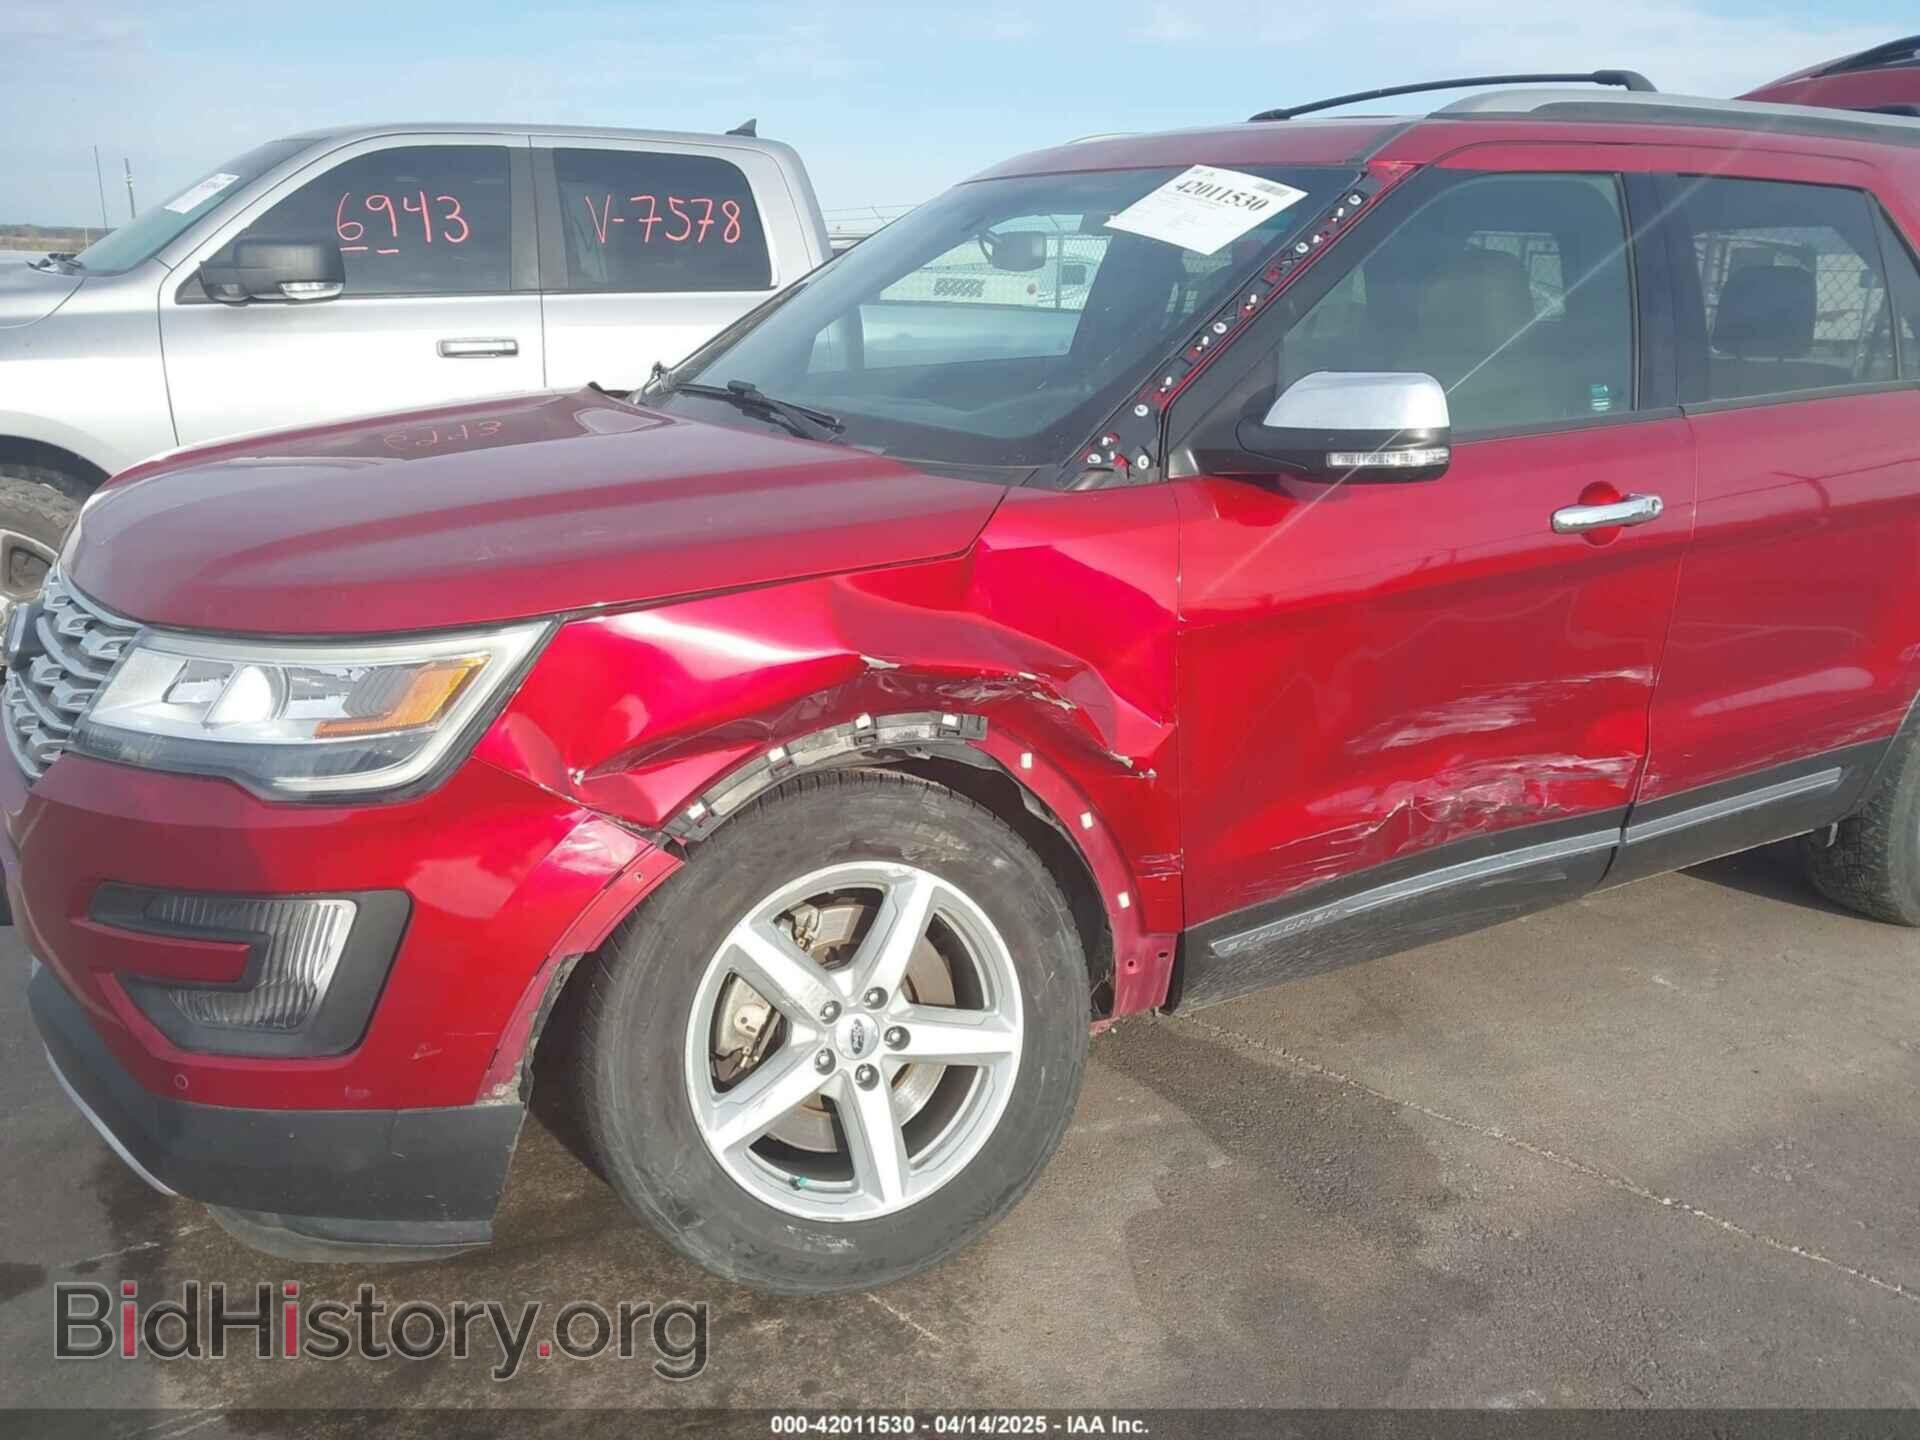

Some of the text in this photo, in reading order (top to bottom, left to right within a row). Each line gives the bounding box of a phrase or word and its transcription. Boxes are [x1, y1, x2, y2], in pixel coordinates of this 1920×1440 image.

[335, 191, 469, 244] 6943
[585, 193, 742, 244] V-7578
[1177, 180, 1269, 211] 42011530
